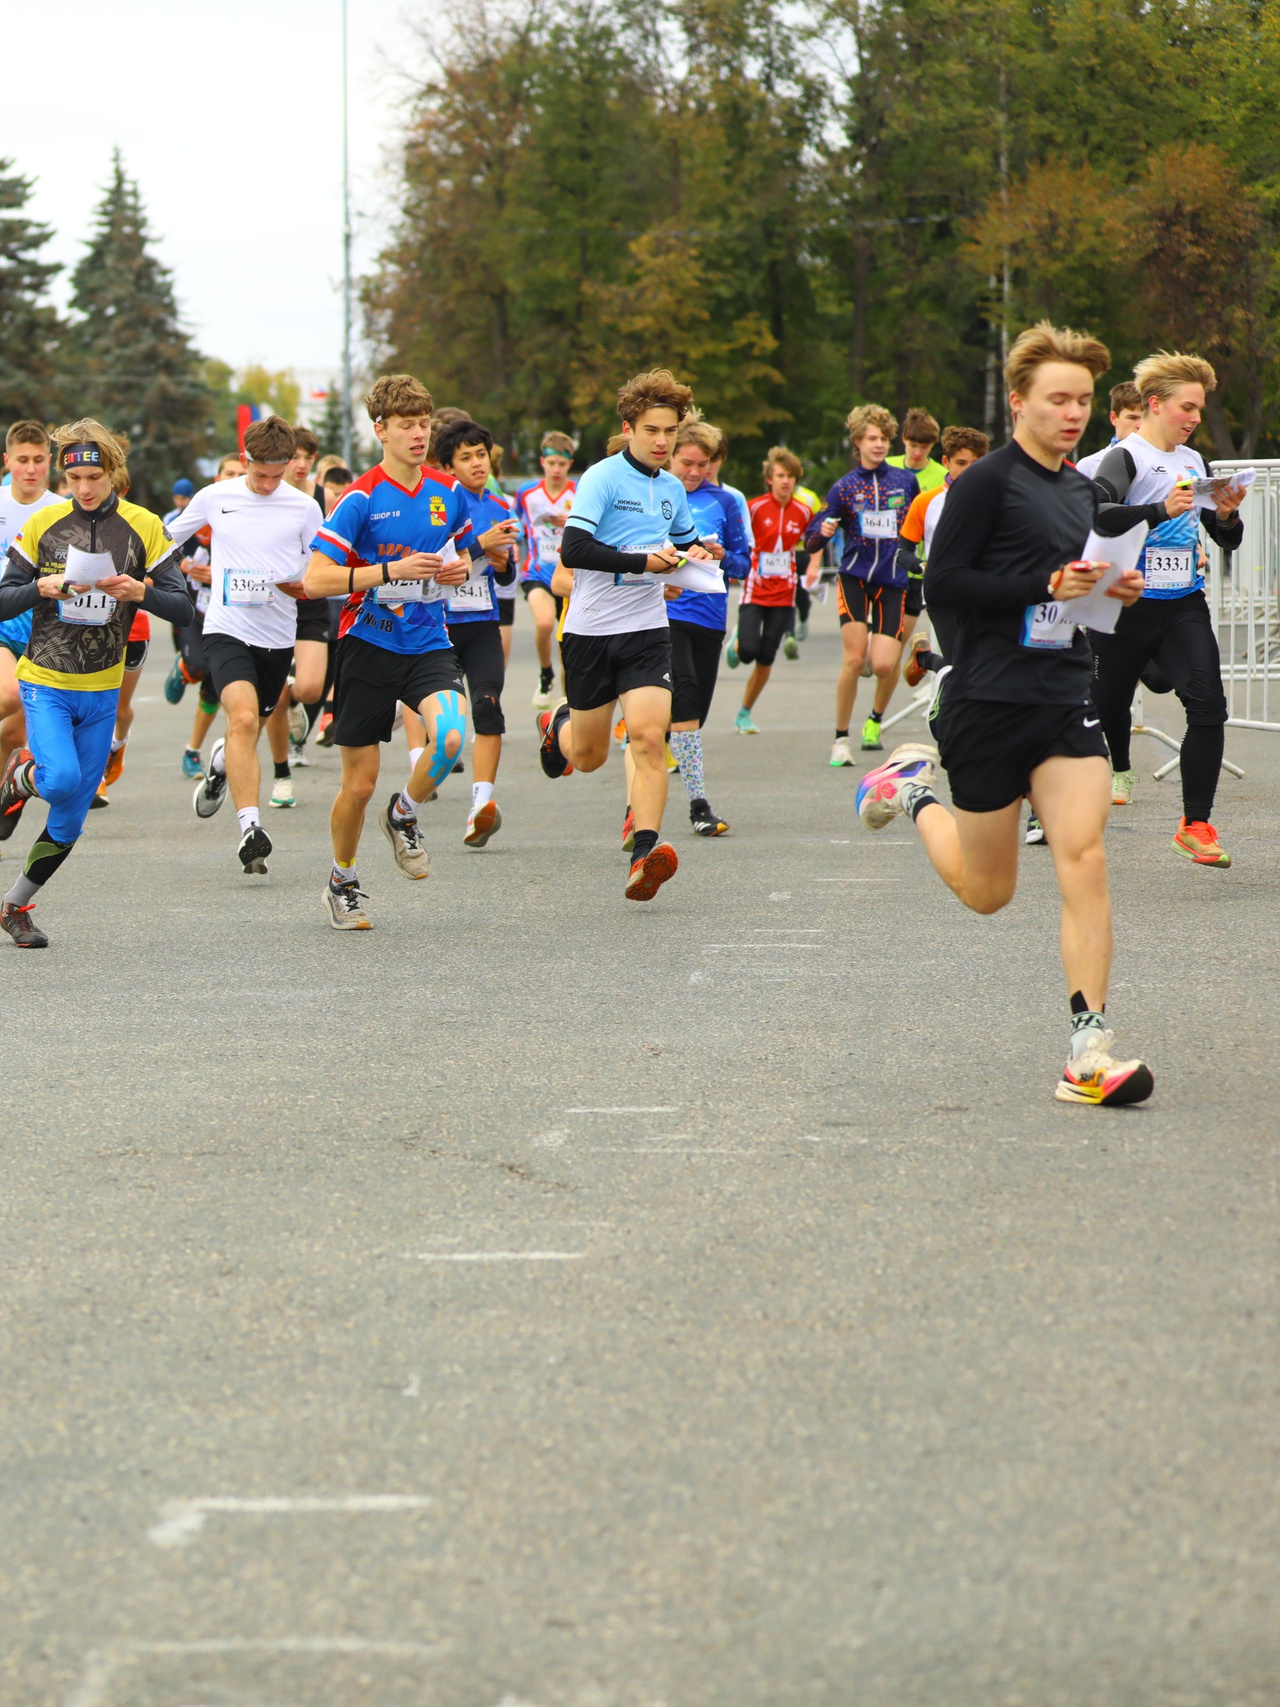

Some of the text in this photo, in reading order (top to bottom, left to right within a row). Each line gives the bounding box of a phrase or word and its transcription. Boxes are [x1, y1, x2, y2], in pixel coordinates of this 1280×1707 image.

[63, 451, 102, 466] ENTEE
[614, 505, 644, 514] НОВГОРОД
[617, 499, 642, 507] НИЖНИЙ
[864, 517, 890, 528] 364.1
[54, 551, 68, 560] РУС
[1153, 557, 1190, 571] 333.1
[74, 594, 108, 609] 01.1
[1035, 603, 1073, 625] 30.
[379, 618, 394, 634] 18
